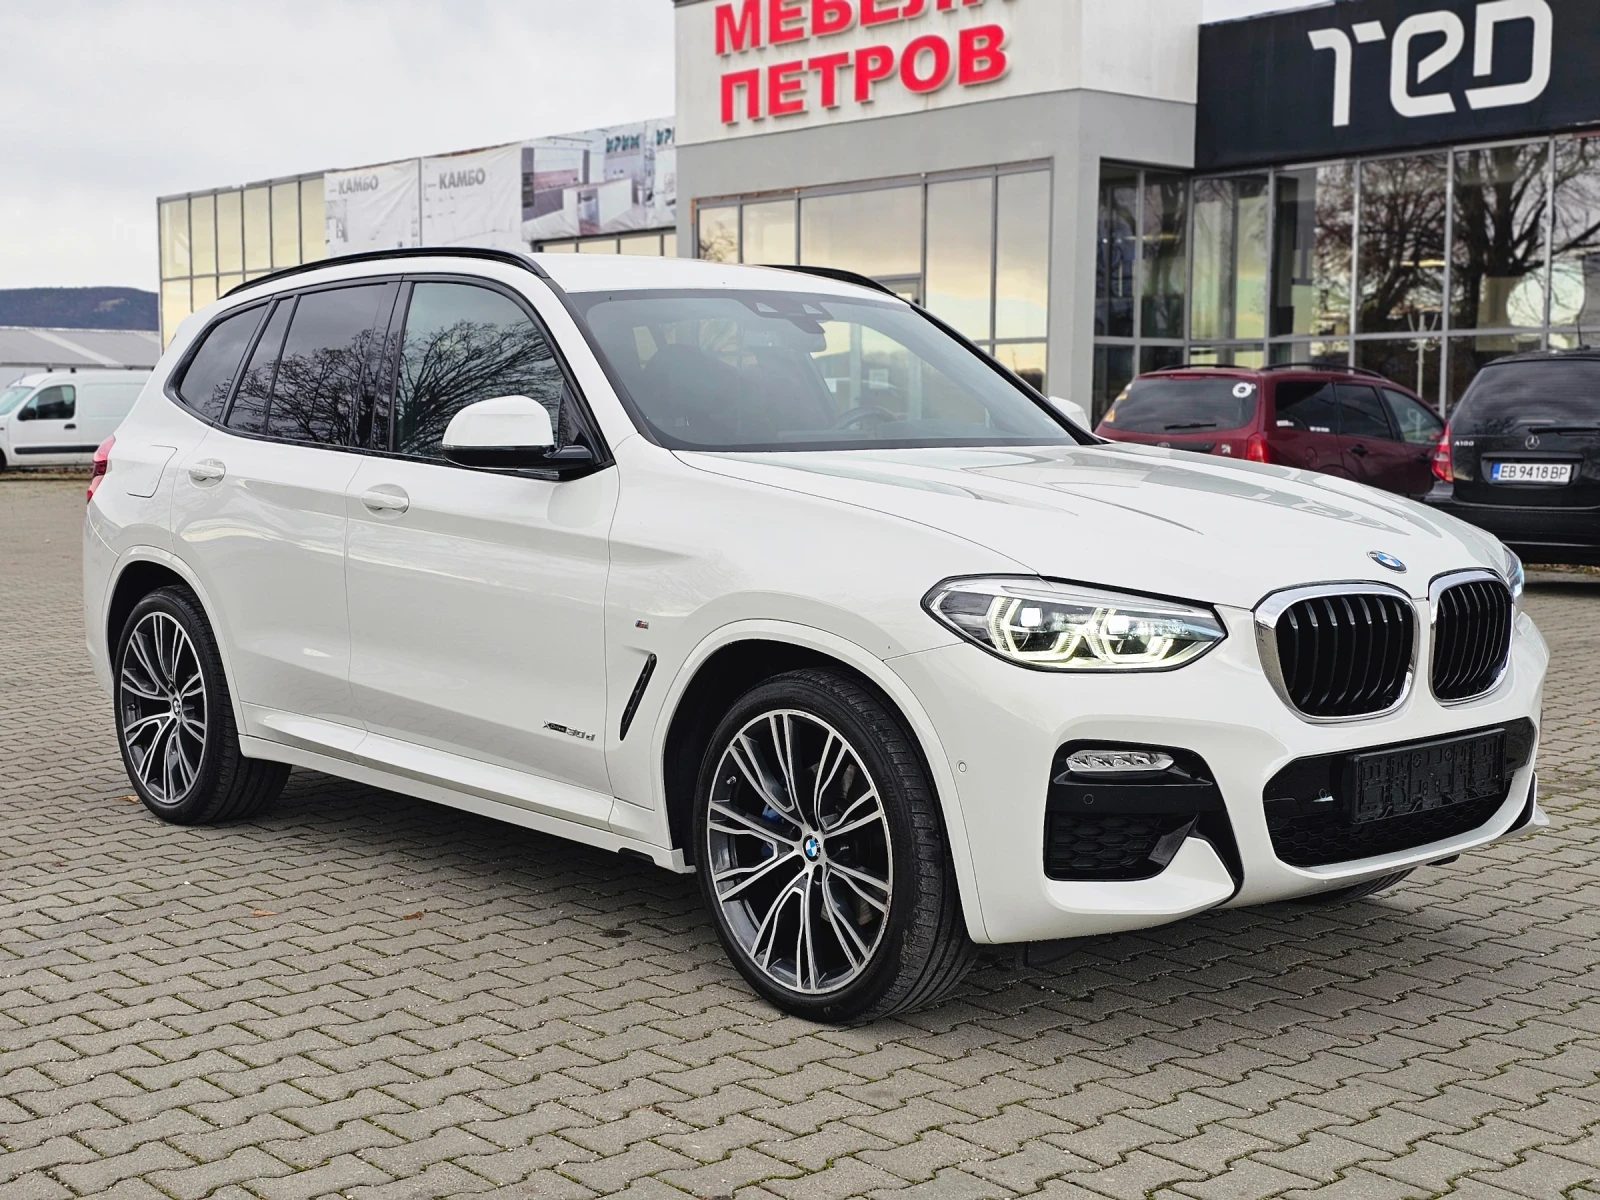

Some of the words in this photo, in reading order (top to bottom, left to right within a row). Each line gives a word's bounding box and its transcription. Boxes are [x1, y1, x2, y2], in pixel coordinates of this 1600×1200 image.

[715, 0, 978, 54] МЕБ
[720, 24, 1008, 123] ПЕТРОВ
[338, 174, 379, 195] КАМБО
[439, 168, 486, 190] КАМБО
[1520, 465, 1549, 479] 9418
[1550, 466, 1568, 480] BP
